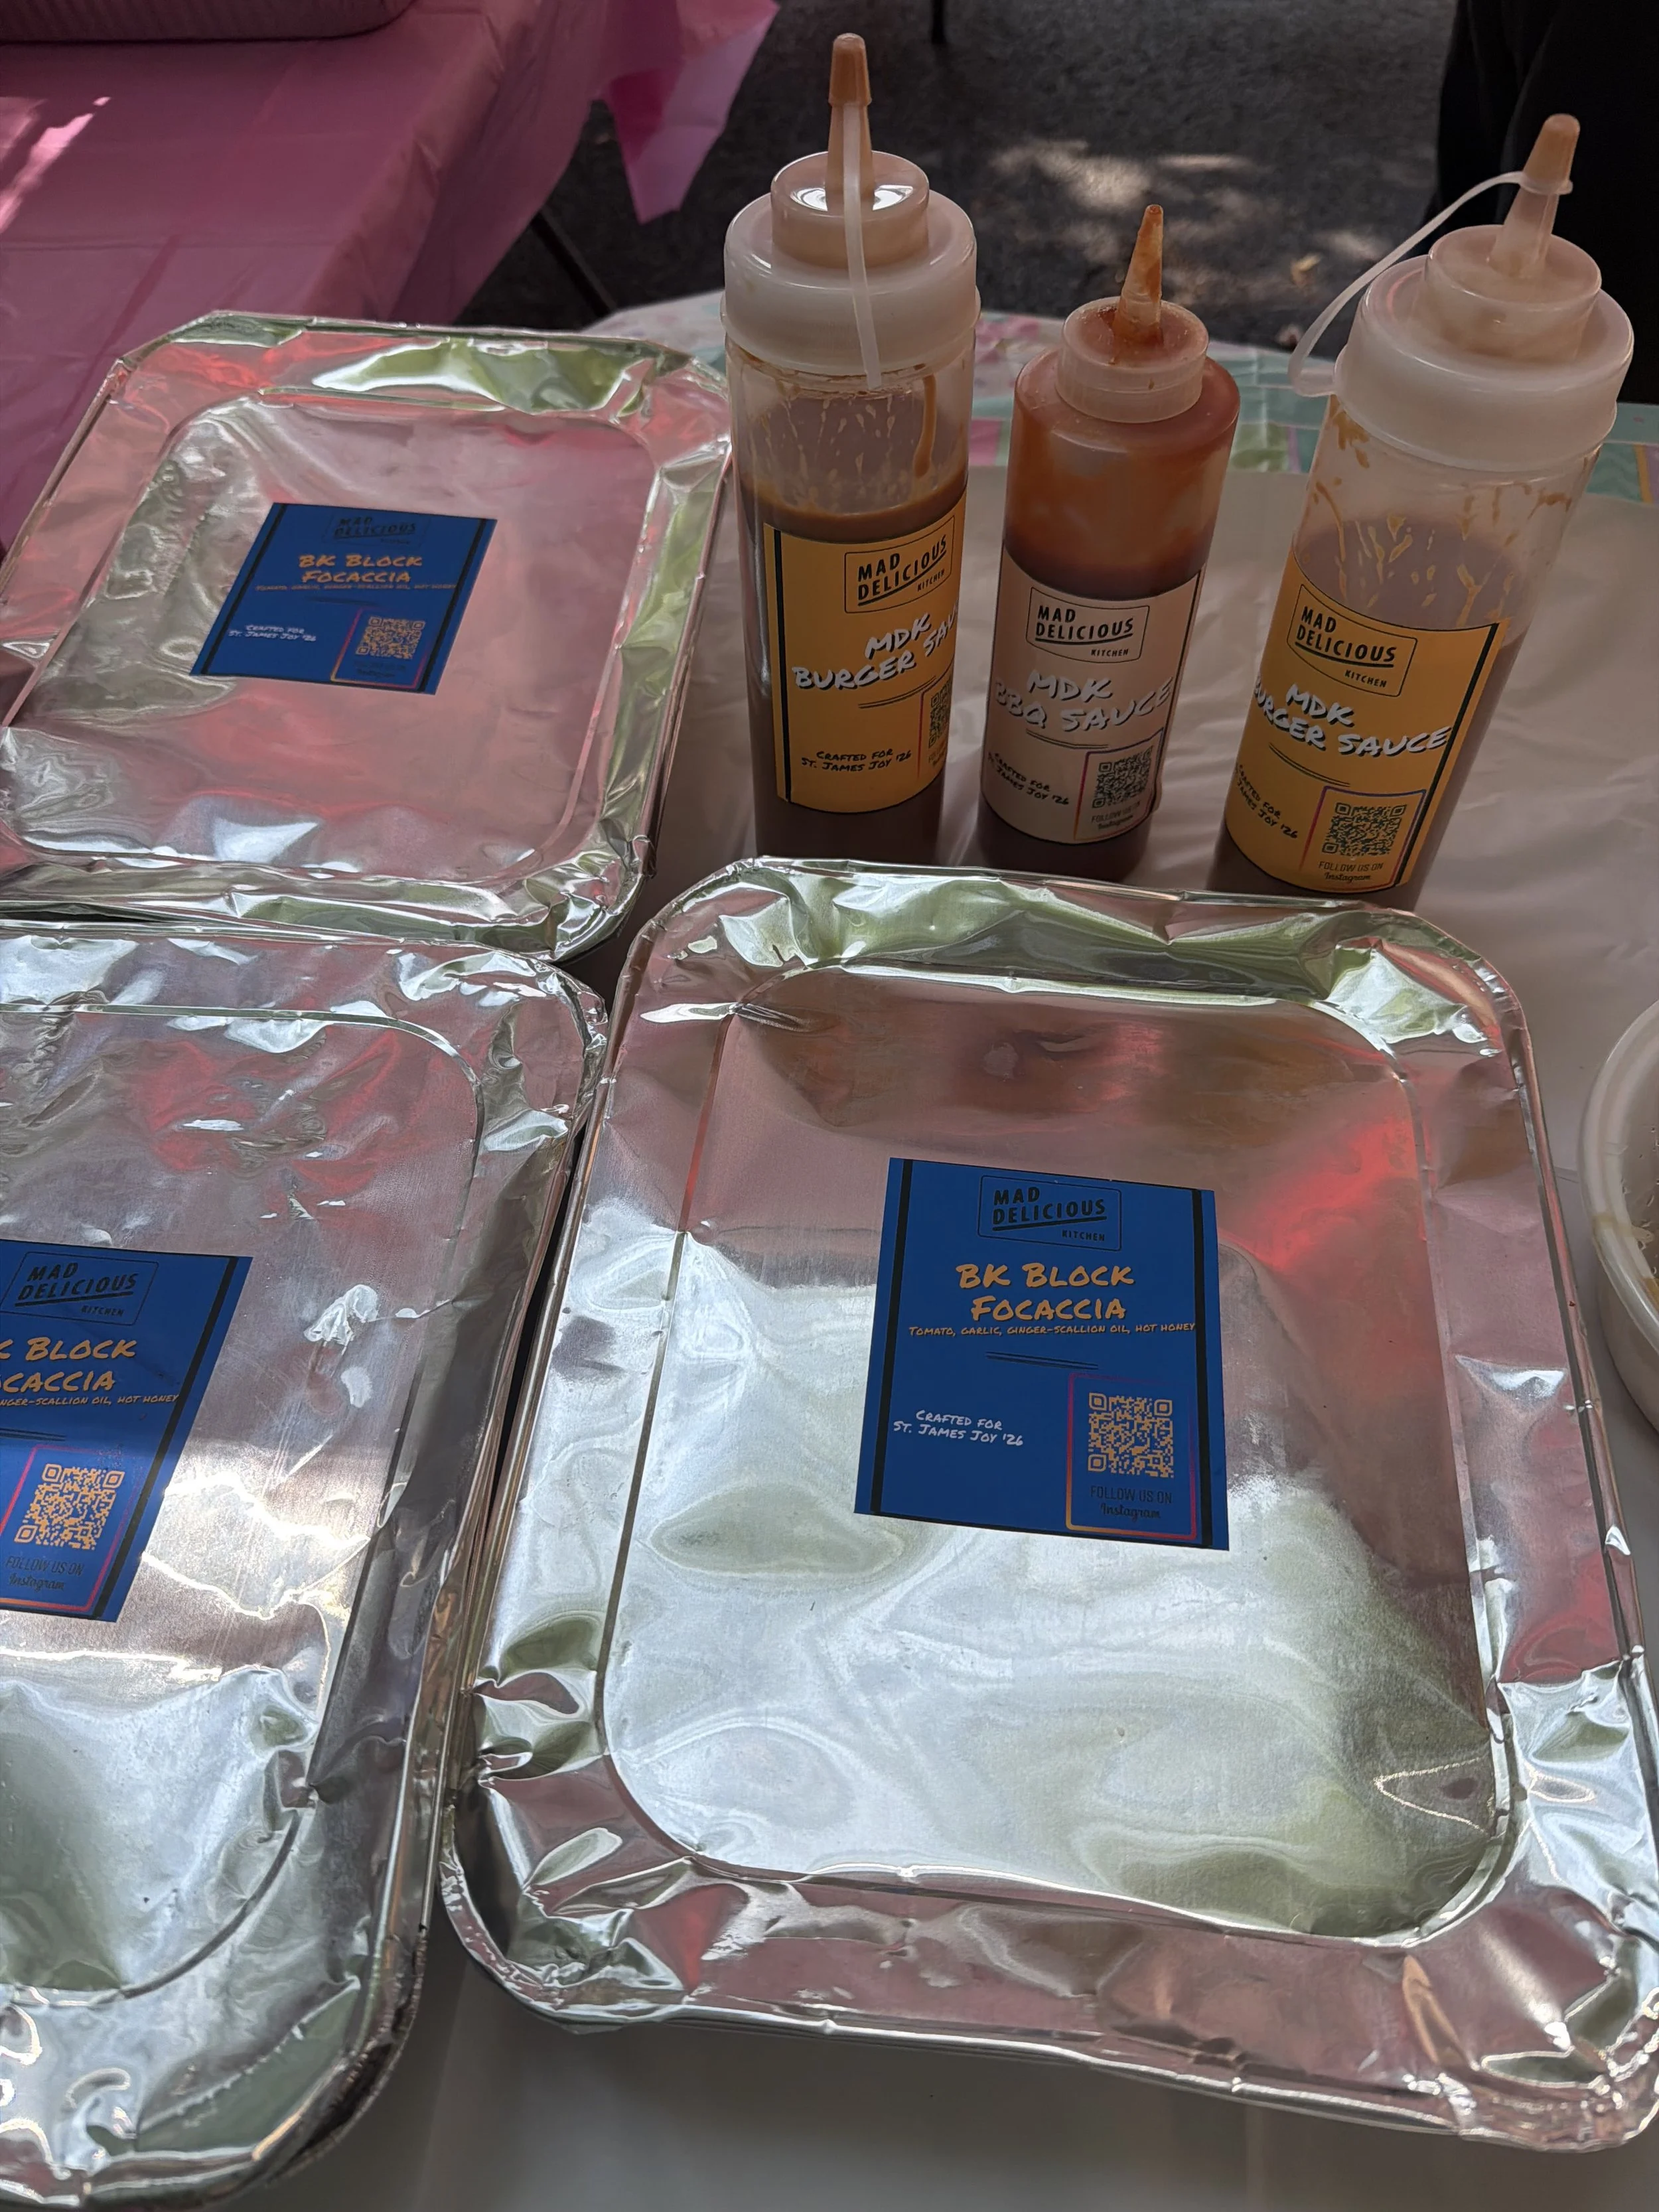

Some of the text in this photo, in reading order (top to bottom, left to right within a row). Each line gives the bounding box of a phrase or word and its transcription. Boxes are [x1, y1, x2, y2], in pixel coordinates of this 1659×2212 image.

[299, 554, 423, 568] BK BLOCK
[858, 552, 901, 582] MAD
[858, 534, 947, 601] DELICIOUS
[302, 569, 411, 583] FOCACCIA
[917, 569, 945, 593] KITCHEN
[1037, 605, 1076, 623] MAD
[1301, 606, 1336, 634] MAD
[865, 613, 932, 660] MDK
[1035, 617, 1135, 641] DELICIOUS
[792, 603, 958, 691] BURGER SAU
[1090, 648, 1129, 657] KITCHEN
[1296, 624, 1398, 663] DELICIOUS
[1027, 670, 1113, 703] MDK
[1344, 669, 1387, 688] KITCHEN
[995, 676, 1174, 733] BBQ SAUCE
[1285, 683, 1354, 727] MDK
[1337, 726, 1452, 758] SAUCE
[801, 757, 817, 769] ST.
[822, 761, 865, 772] JAMES
[868, 759, 891, 771] JOY
[816, 748, 894, 762] CRAFTED FOR
[1027, 788, 1048, 800] JOY
[1031, 780, 1050, 792] FOR
[1258, 808, 1278, 827] JOY
[1263, 801, 1281, 820] FOR
[1319, 861, 1384, 873] FOLLOW US ON
[1325, 871, 1372, 885] Instagram
[993, 1186, 1041, 1206] MAD
[992, 1199, 1106, 1226] DELICIOUS
[1062, 1229, 1106, 1242] KITCHEN
[27, 1262, 78, 1282] MAD
[956, 1262, 1135, 1289] BK BLOCK
[19, 1272, 138, 1301] DELICIOUS
[80, 1304, 125, 1317] KITCHEN
[971, 1295, 1127, 1323] FOCACCIA
[909, 1322, 1196, 1338] TOMATO, GARLIC, GINGER-SCALLION OIL, HOT HONEY
[25, 1336, 137, 1361] BLOCK
[0, 1370, 115, 1393] CACCIA
[0, 1394, 180, 1407] NGER-SCALLION OIL, HOT HONEY
[916, 1409, 1003, 1431] CRAFTED FOR
[893, 1420, 1024, 1447] ST. JAMES JOY '26
[1090, 1485, 1173, 1504] FOLLOW US ON
[1100, 1503, 1161, 1522] Instagram
[6, 1556, 85, 1576] FOLLOW US ON
[9, 1572, 65, 1592] Instagram
